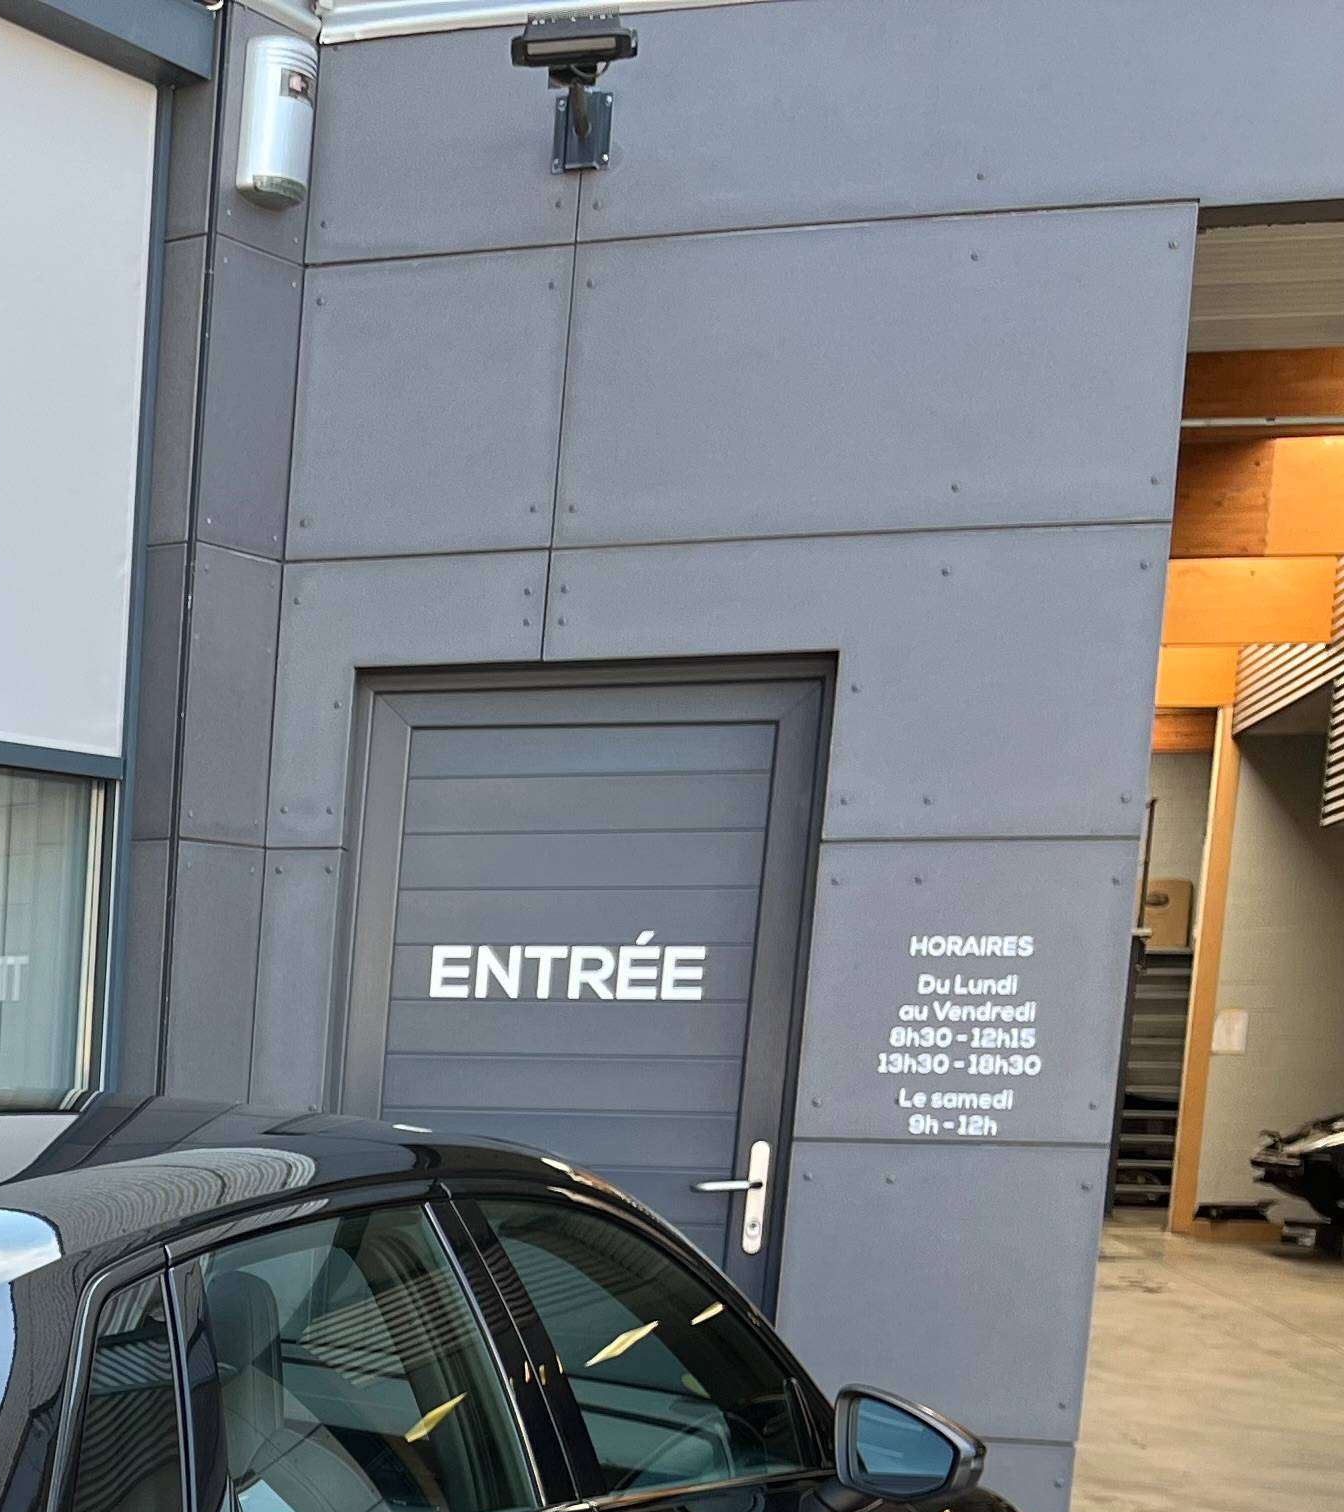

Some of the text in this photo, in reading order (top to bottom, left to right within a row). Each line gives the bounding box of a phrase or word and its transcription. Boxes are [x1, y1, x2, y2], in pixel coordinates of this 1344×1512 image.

[909, 935, 1034, 957] HORAIRES
[427, 930, 709, 1002] ENTRÉE
[917, 973, 1018, 996] Du Lundi
[898, 1000, 1037, 1023] au Vendredi
[888, 1026, 953, 1048] 8h30
[970, 1027, 1037, 1049] 12h15
[876, 1052, 950, 1074] 13h30
[966, 1053, 1043, 1076] 18h30
[898, 1087, 1014, 1110] Le samedi
[908, 1113, 940, 1135] 9h
[956, 1114, 999, 1136] 12h
